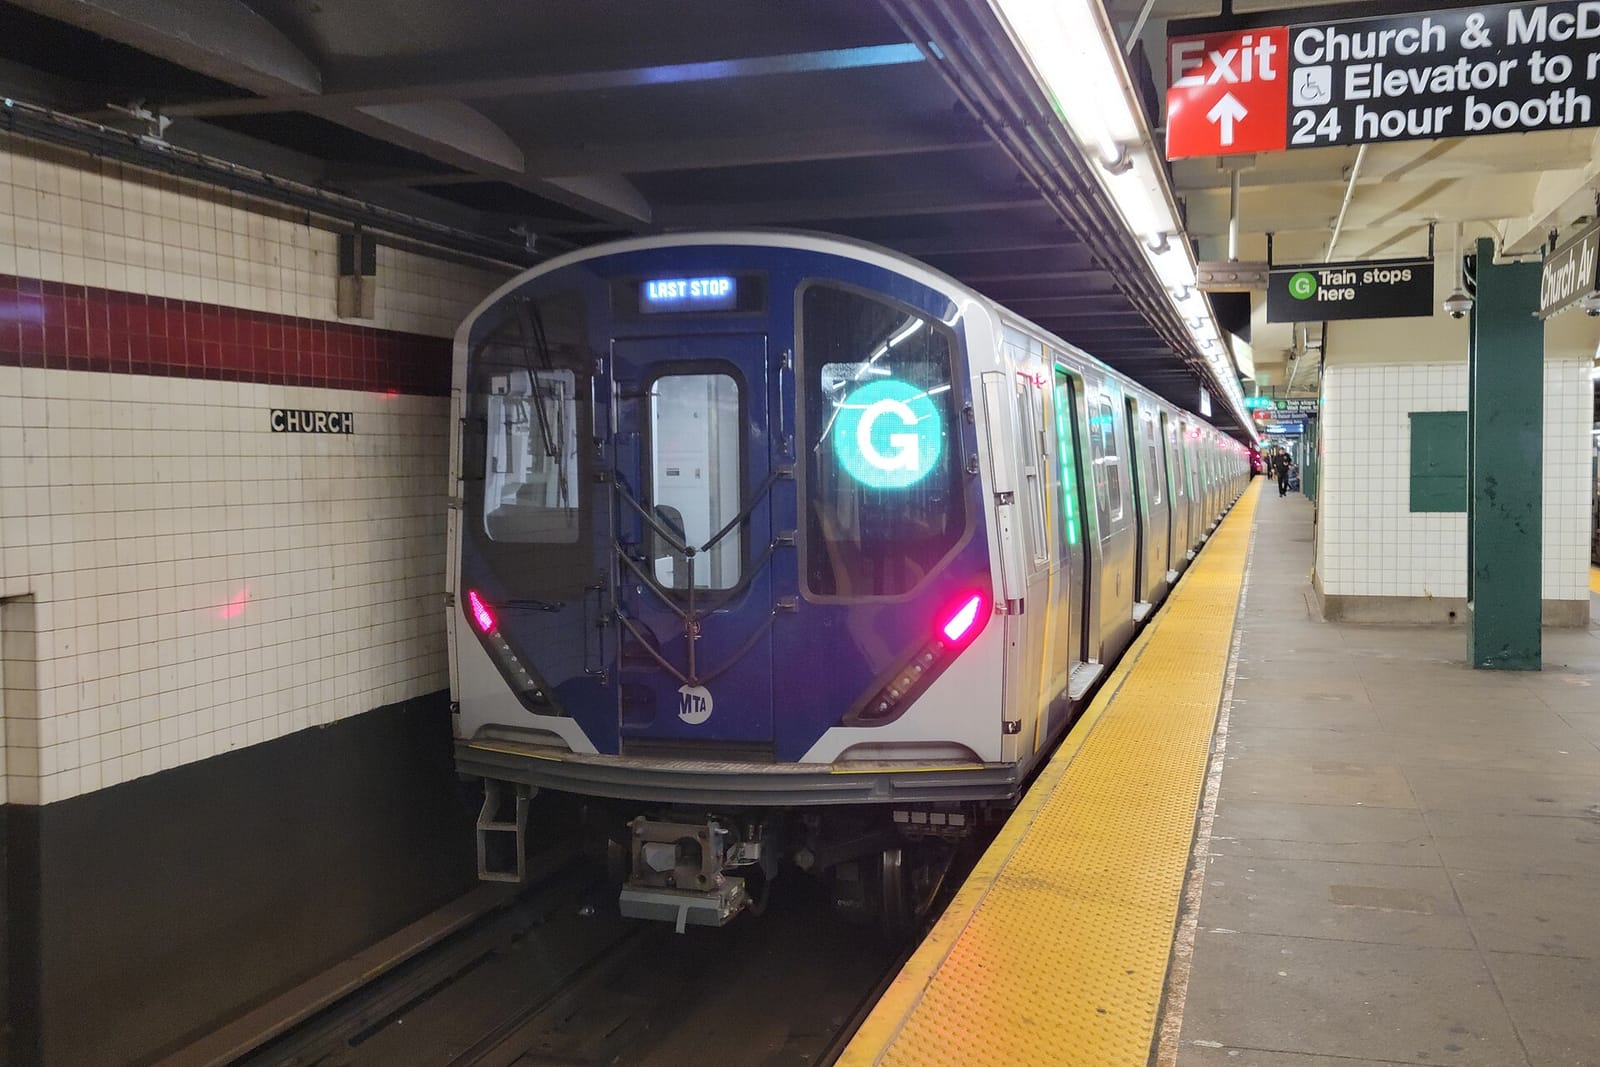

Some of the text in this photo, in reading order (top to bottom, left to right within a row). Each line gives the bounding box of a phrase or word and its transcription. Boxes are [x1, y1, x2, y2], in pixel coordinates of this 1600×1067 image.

[1293, 2, 1600, 65] Church & McD
[1171, 35, 1277, 88] Exit
[1345, 57, 1518, 101] Elevator
[1527, 50, 1573, 85] to
[1291, 87, 1592, 145] 24 hour booth
[649, 279, 729, 299] LAST STOP
[1295, 277, 1310, 294] G
[1317, 286, 1355, 301] here
[1318, 267, 1412, 286] Train stops
[1541, 239, 1595, 311] Church Av
[271, 409, 353, 433] CHURCH
[857, 398, 919, 472] G
[679, 692, 706, 714] MTA
